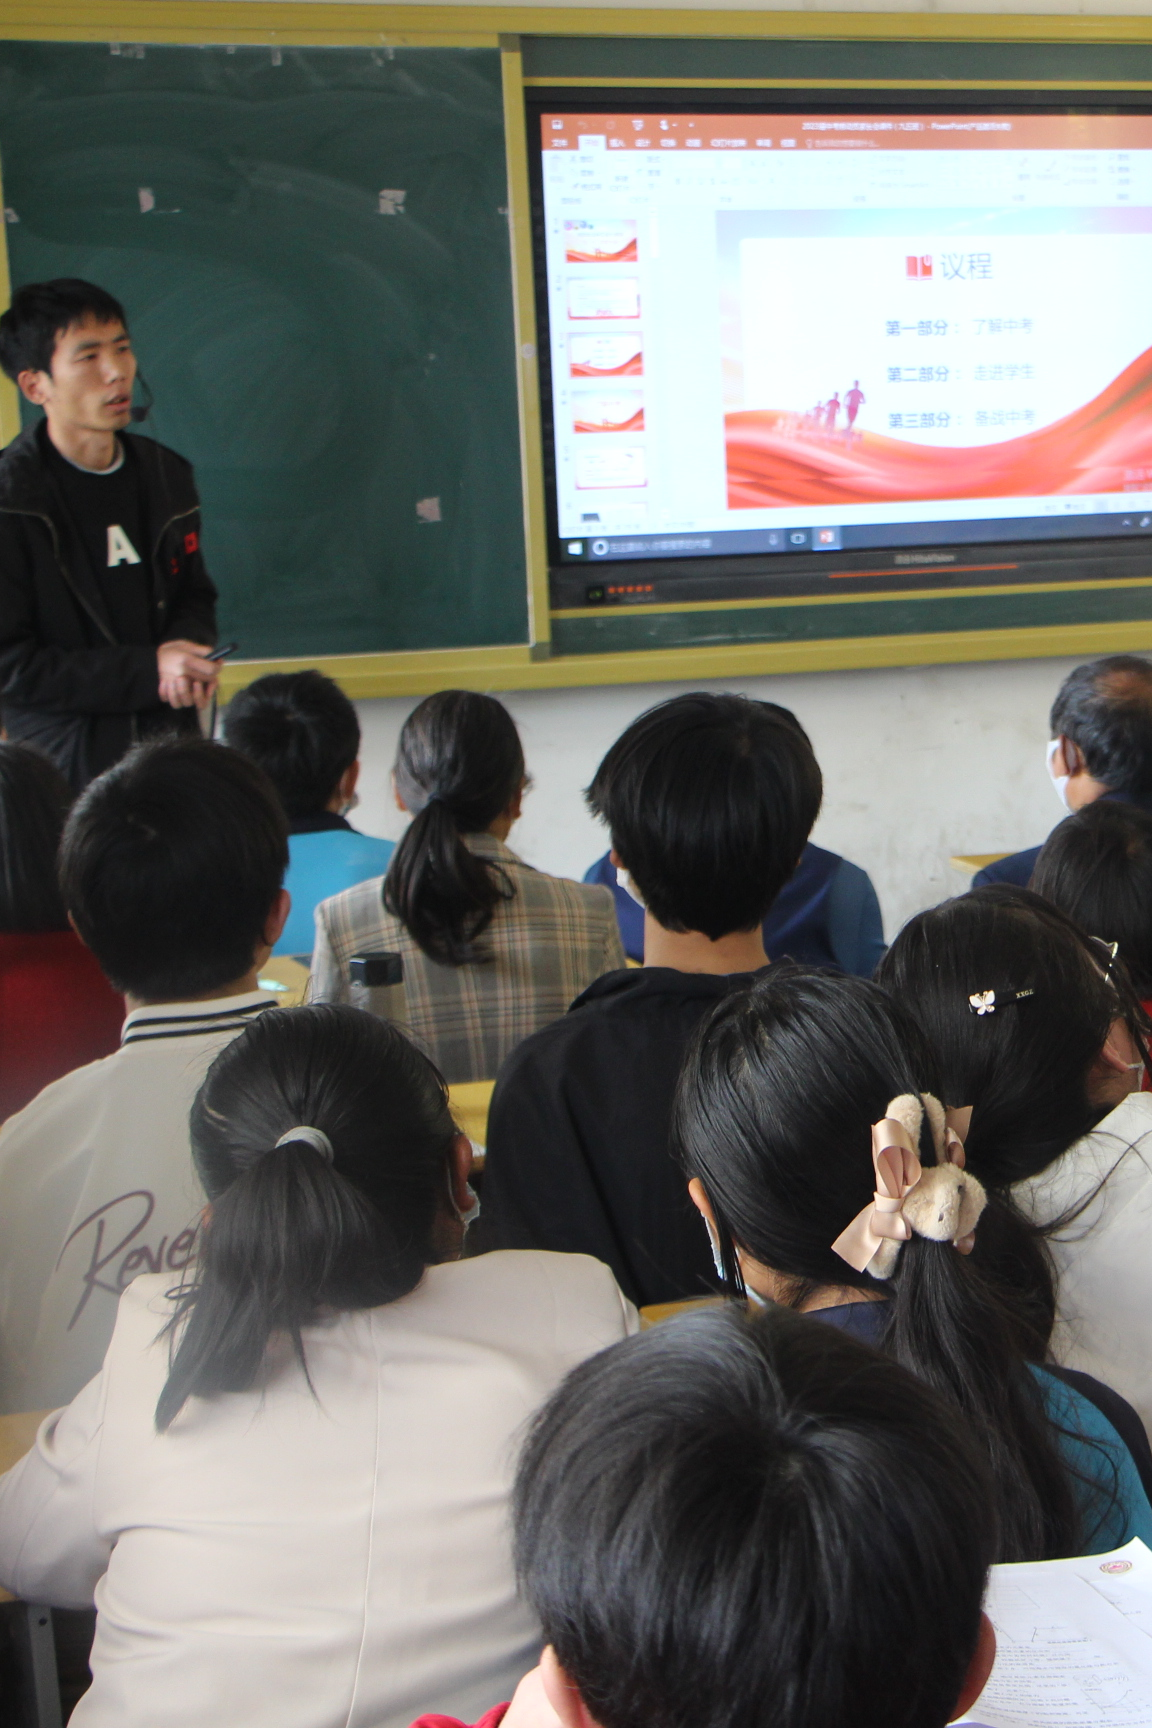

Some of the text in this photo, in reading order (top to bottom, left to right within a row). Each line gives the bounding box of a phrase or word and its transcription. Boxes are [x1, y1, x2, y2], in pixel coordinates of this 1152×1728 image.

[940, 252, 993, 281] 议程
[885, 318, 1034, 337] 第一部分： 了解中考
[887, 366, 960, 384] 第二部分：
[888, 411, 961, 430] 第三部分：
[107, 524, 141, 567] A
